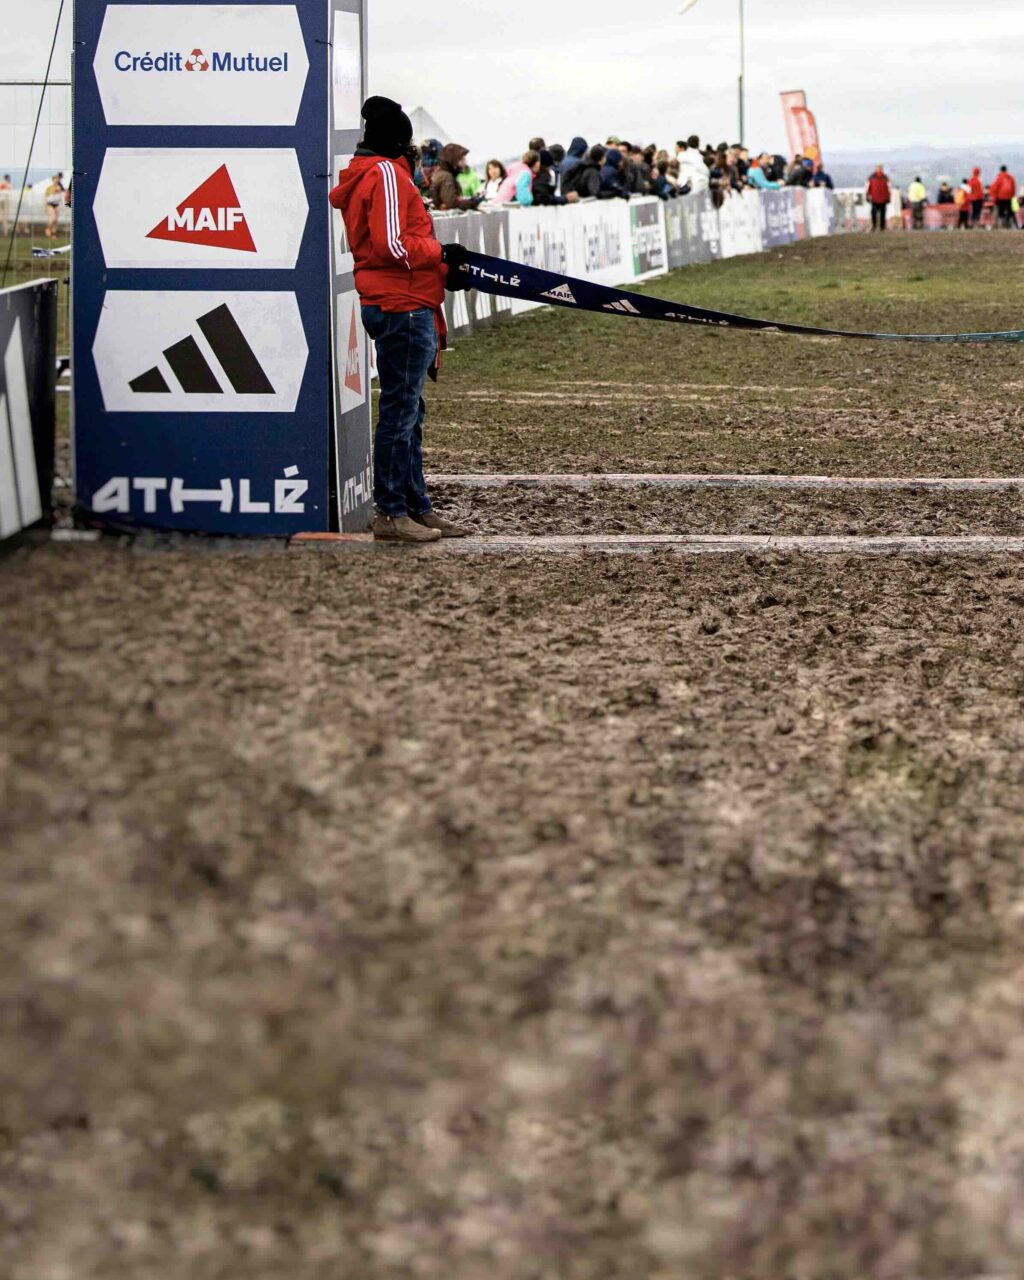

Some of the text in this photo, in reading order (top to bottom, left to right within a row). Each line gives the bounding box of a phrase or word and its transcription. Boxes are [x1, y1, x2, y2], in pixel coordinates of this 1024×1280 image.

[114, 50, 289, 72] Crédit Mutuel
[167, 207, 245, 231] MAIF
[547, 290, 573, 299] MAIF
[92, 464, 309, 513] ATHLÉ
